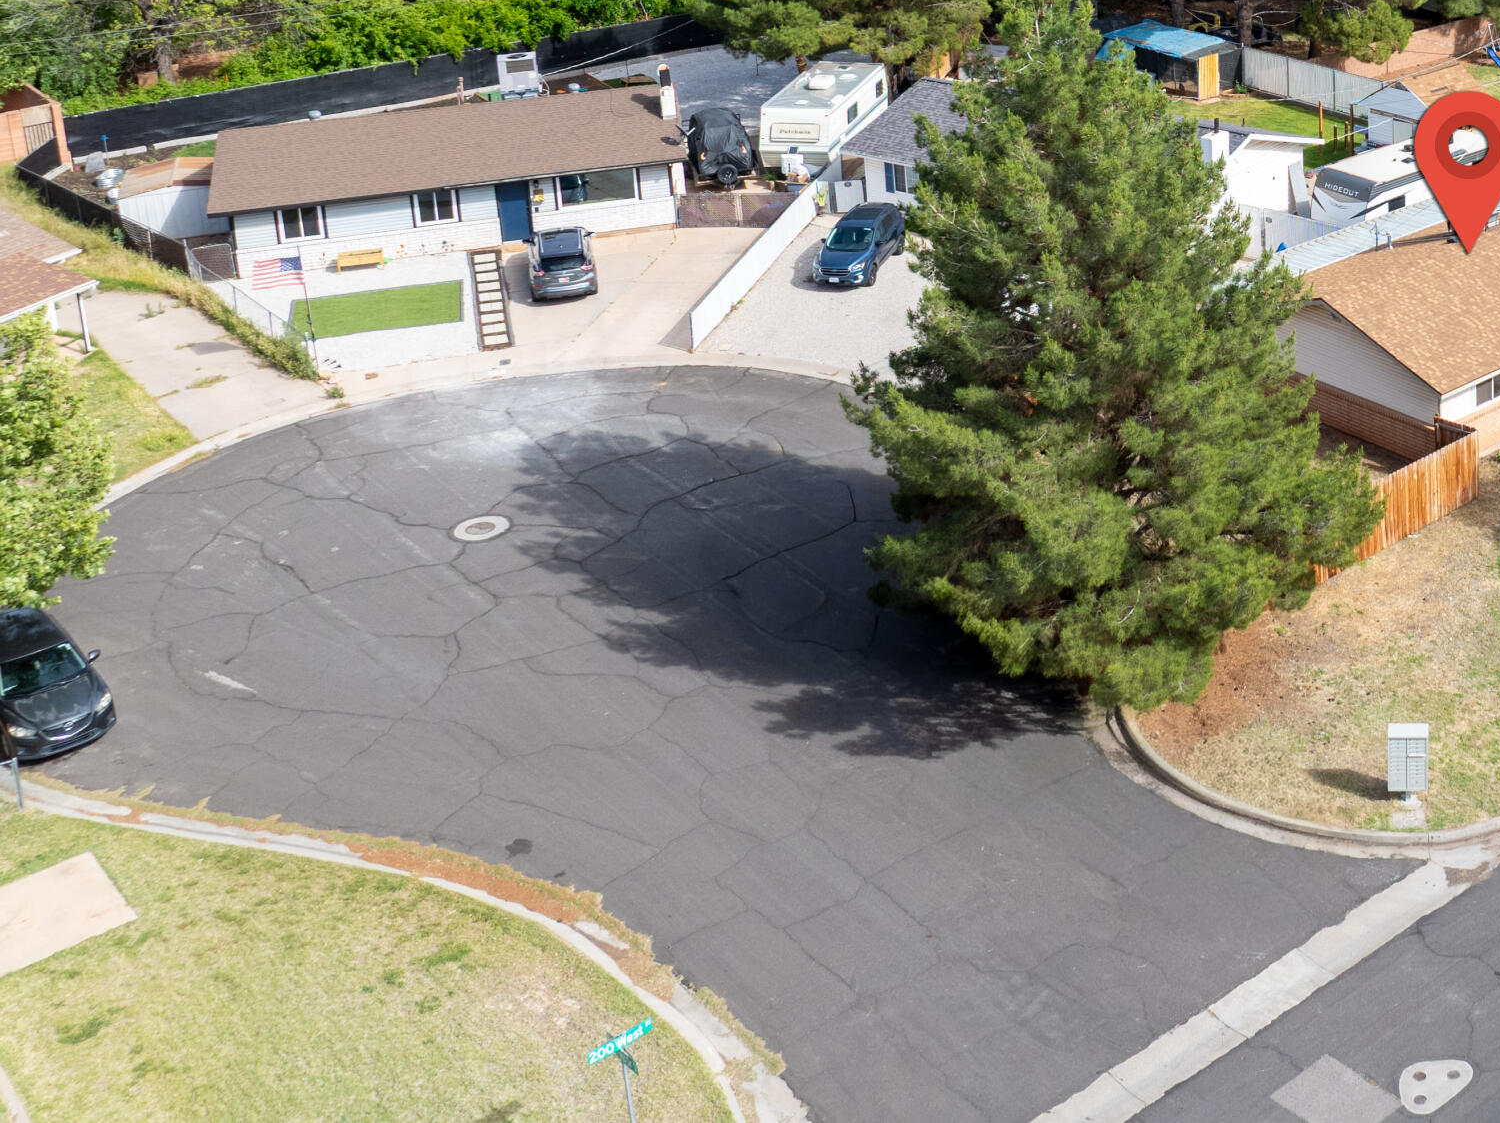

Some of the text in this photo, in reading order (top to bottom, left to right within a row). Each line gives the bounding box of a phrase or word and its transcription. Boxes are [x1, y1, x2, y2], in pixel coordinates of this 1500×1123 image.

[1324, 182, 1360, 197] HIDEOUT
[589, 1042, 615, 1065] 200
[614, 1024, 644, 1049] West
